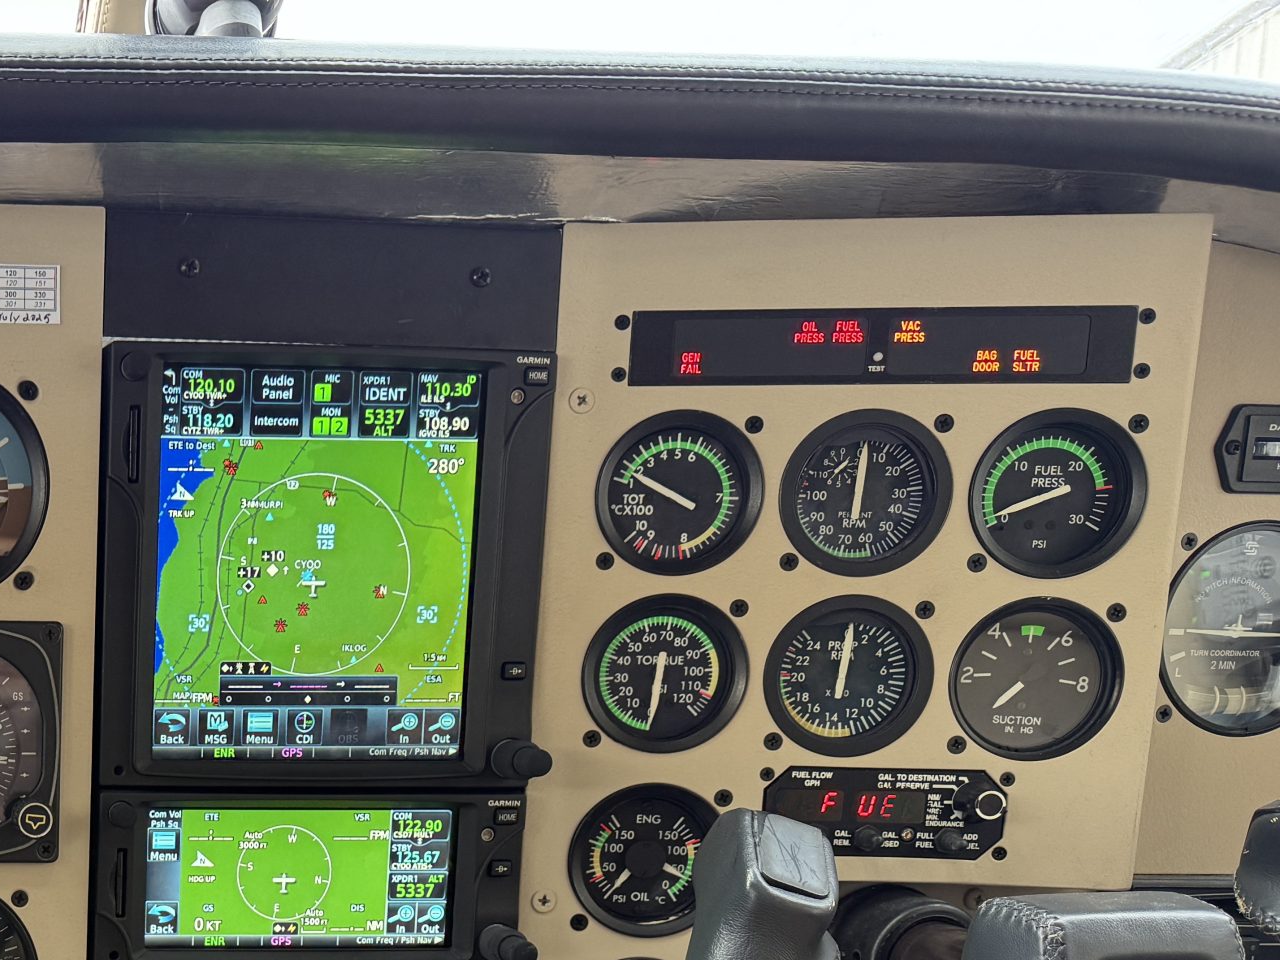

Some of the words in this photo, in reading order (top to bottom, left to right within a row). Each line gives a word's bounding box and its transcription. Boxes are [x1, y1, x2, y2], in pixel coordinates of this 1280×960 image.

[802, 322, 818, 332] OIL
[836, 321, 860, 331] FUEL
[901, 321, 921, 331] VAC
[794, 333, 824, 343] PRESS
[832, 333, 863, 343] PRESS
[894, 332, 925, 343] PRESS
[516, 356, 551, 365] GARMIN
[681, 352, 701, 364] GEN
[976, 350, 997, 361] BAG
[1014, 350, 1040, 360] FUEL
[680, 364, 701, 375] FAIL
[972, 362, 999, 372] DOOR
[1012, 362, 1039, 372] SLTR
[262, 375, 294, 387] Audio
[529, 371, 548, 381] HOME
[263, 388, 293, 400] Panel
[365, 388, 406, 401] IDENT
[254, 415, 298, 426] Intercom
[365, 409, 405, 425] 5337
[439, 444, 456, 454] TRK
[428, 458, 465, 475] 280°
[1034, 465, 1063, 476] FUEL
[1031, 476, 1065, 489] PRESS
[1032, 540, 1046, 550] PSI
[1210, 661, 1217, 669] 2
[1218, 661, 1235, 670] MIN
[992, 714, 1041, 727] SUCTION
[160, 733, 184, 745] Back
[204, 734, 227, 745] MSG
[246, 734, 273, 745] Menu
[431, 733, 450, 744] Out
[811, 771, 833, 780] FLOW
[805, 779, 820, 787] GPH
[636, 813, 661, 825] ENG
[396, 884, 434, 899] 5337
[631, 890, 650, 903] OIL
